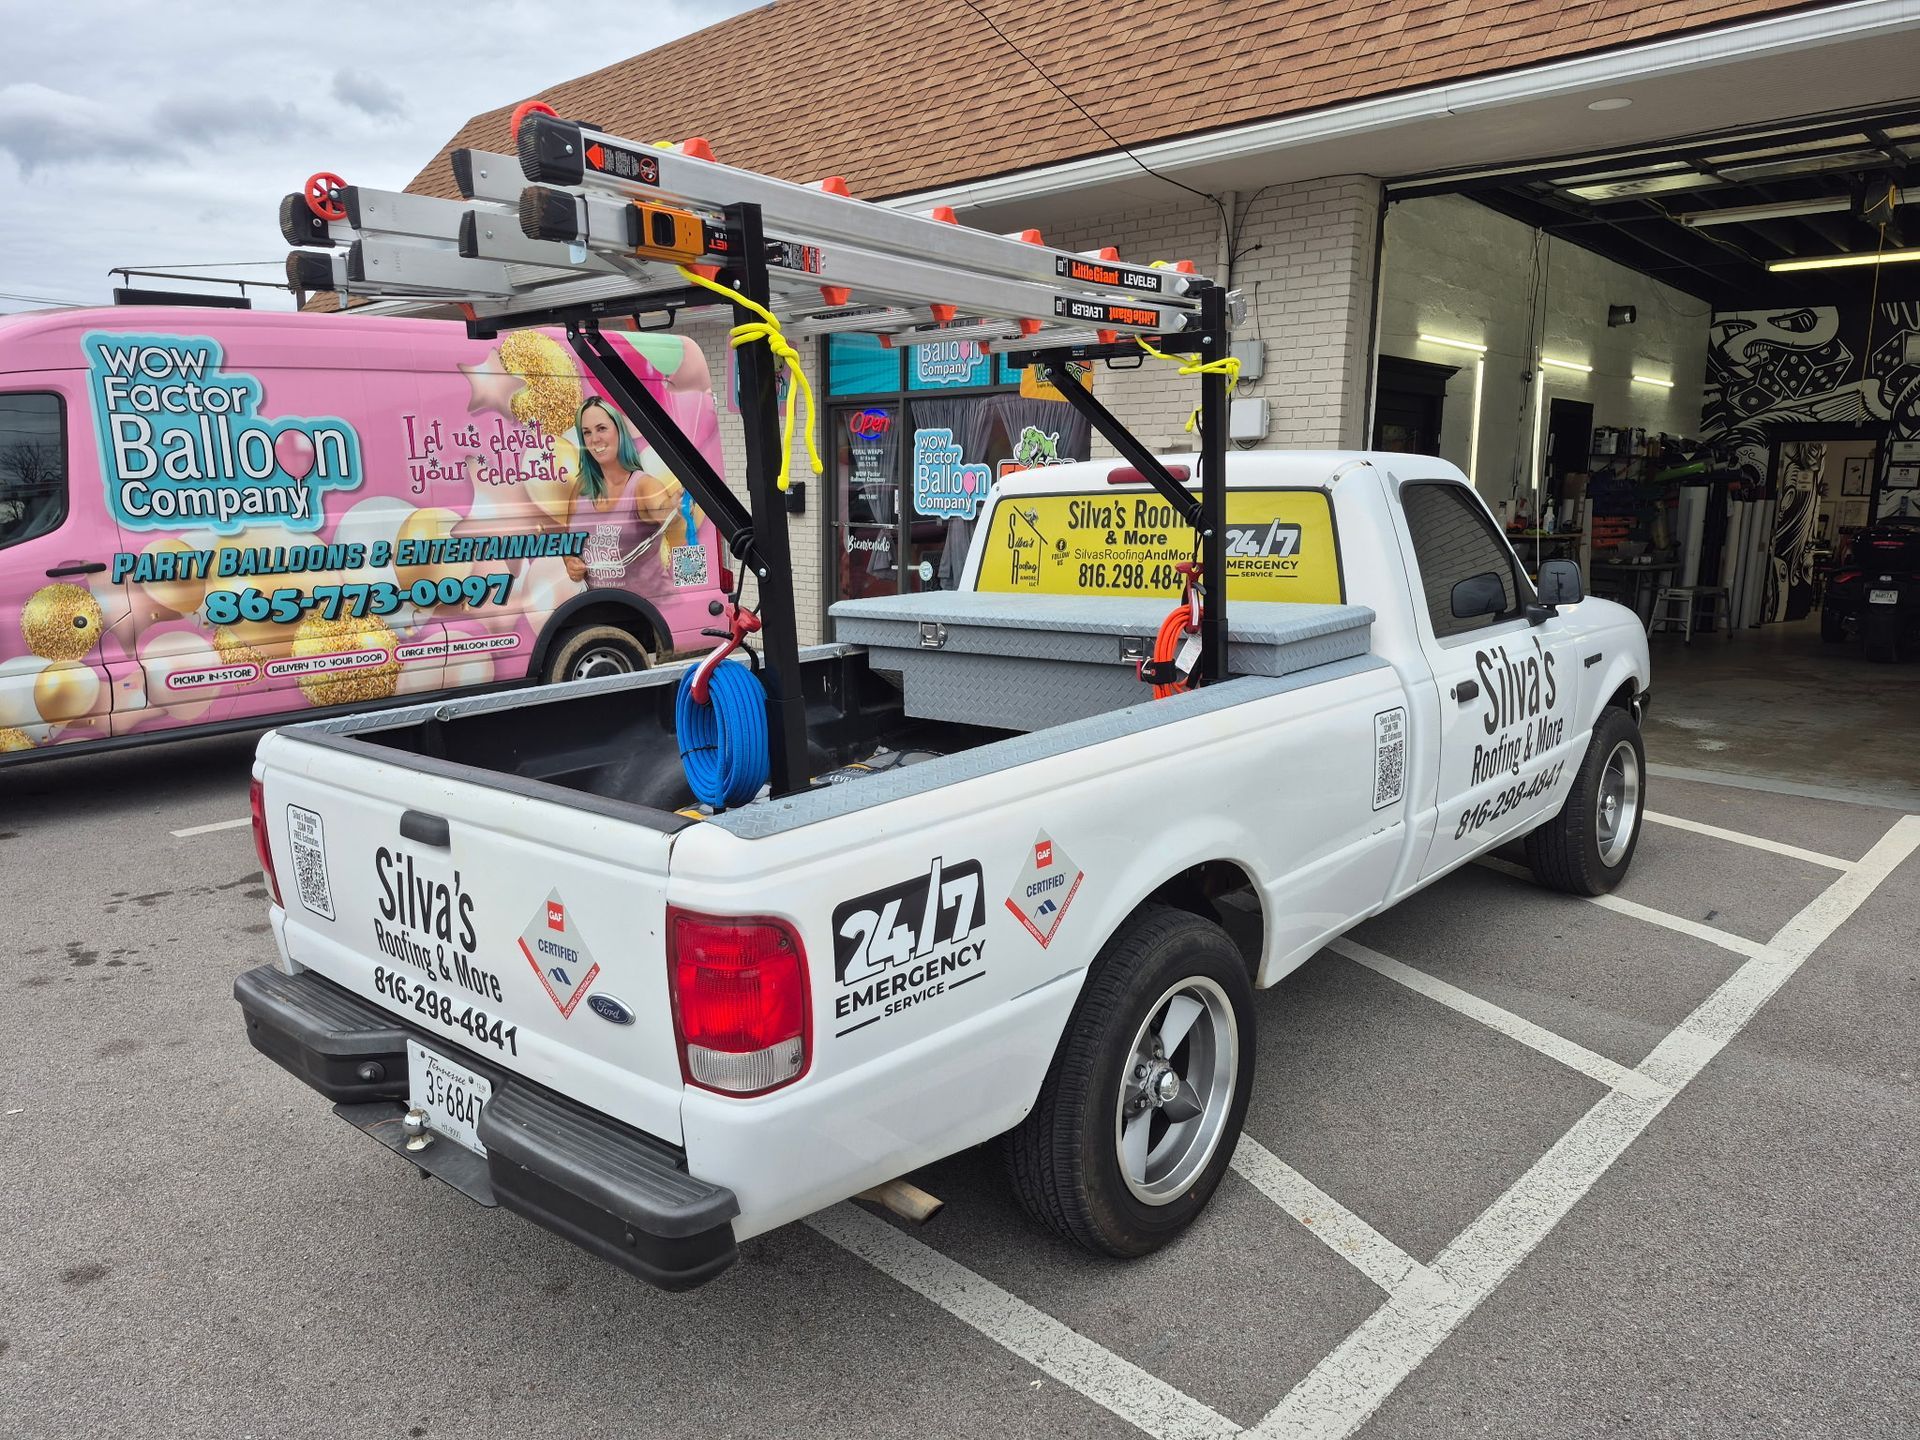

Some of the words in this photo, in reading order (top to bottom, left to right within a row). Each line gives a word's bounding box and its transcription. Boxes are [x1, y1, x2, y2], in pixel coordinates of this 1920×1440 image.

[1123, 272, 1157, 289] LEVELER
[1071, 302, 1103, 319] LEVELER
[98, 344, 207, 379] WOW
[921, 361, 967, 377] Company
[103, 376, 248, 413] Factor
[850, 411, 890, 434] Open
[109, 413, 349, 481] Balloon
[403, 415, 443, 460] Let
[452, 430, 481, 449] us
[490, 419, 556, 452] elevate
[919, 435, 948, 449] WOW
[919, 450, 958, 464] Factor
[410, 461, 467, 494] your
[477, 451, 568, 486] celebrate
[919, 465, 988, 493] Balloon
[121, 481, 310, 522] Company
[919, 496, 971, 512] Company
[1068, 500, 1126, 529] Silva's
[847, 535, 890, 552] Bienvenido
[1105, 530, 1117, 545] &
[1124, 531, 1168, 545] More
[112, 550, 214, 584] PARTY
[217, 543, 367, 577] BALLOONS
[369, 540, 391, 568] &
[395, 531, 589, 567] ENTERTAINMENT
[1226, 560, 1299, 570] MERGENCY
[205, 573, 516, 625] 865-773-0097
[401, 647, 424, 657] LARGE
[427, 645, 450, 655] EVENT
[453, 641, 488, 652] BALLOON
[490, 637, 515, 648] DECOR
[173, 674, 205, 687] PICKUP
[208, 668, 253, 681] IN-STORE
[271, 661, 310, 674] DELIVERY
[313, 659, 327, 670] TO
[356, 652, 383, 664] DOOR
[1475, 635, 1556, 735] Silva's
[1471, 733, 1522, 787] Roofing
[1523, 722, 1533, 762] &
[1535, 716, 1563, 756] More
[1454, 759, 1565, 840] 816-298-4841
[1037, 848, 1051, 860] GAF
[375, 846, 477, 953] Silva's
[549, 910, 563, 922] GAF
[839, 856, 980, 986] 24/7
[374, 918, 438, 983] Roofing
[438, 943, 453, 982] &
[453, 952, 504, 1003] More
[835, 940, 986, 1019] EMERGENCY
[374, 966, 518, 1057] 816-298-4841
[598, 1001, 621, 1019] Ford
[884, 982, 945, 1017] SERVICE
[428, 1056, 466, 1085] Tennessee
